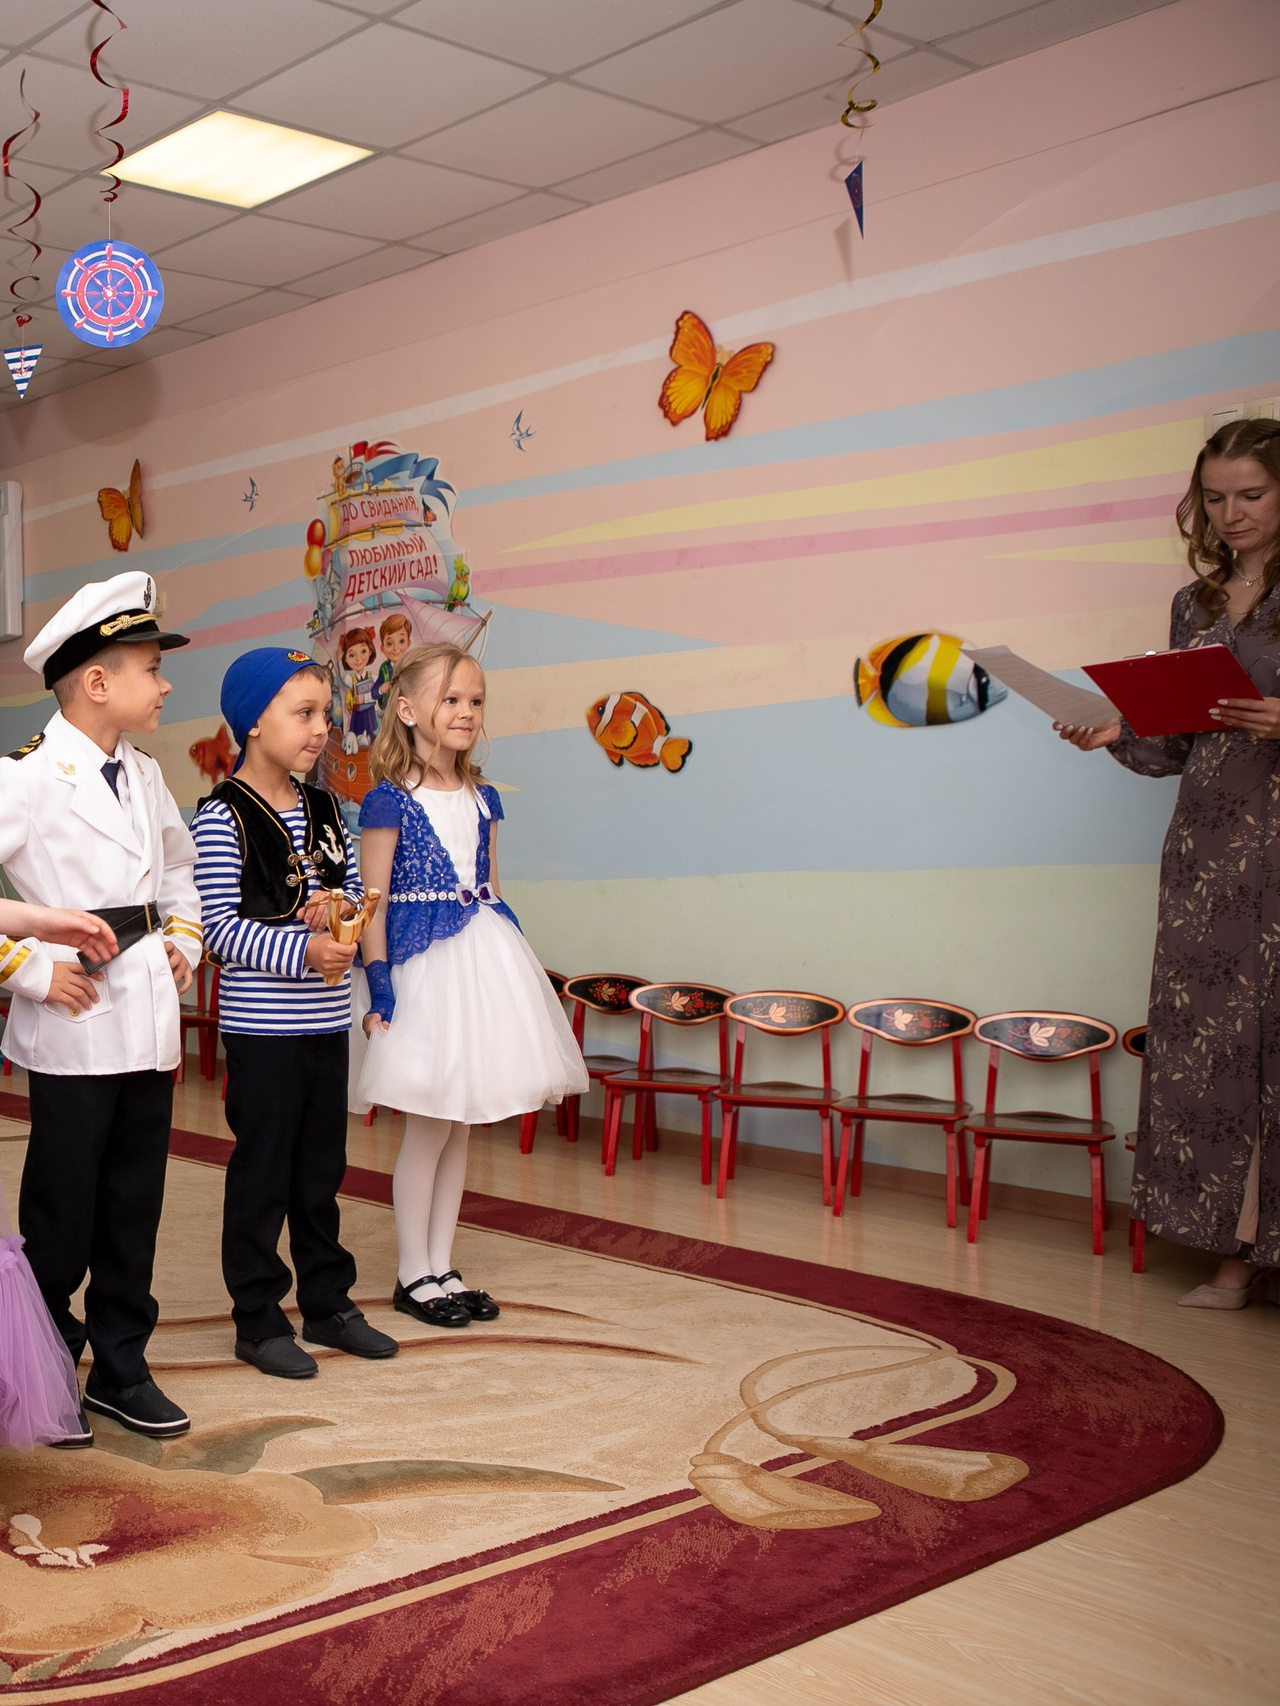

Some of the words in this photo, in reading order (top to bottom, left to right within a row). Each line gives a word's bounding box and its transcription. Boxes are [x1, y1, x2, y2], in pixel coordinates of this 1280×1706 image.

[342, 502, 358, 523] ДО
[361, 496, 419, 518] СВИДАНИЯ,
[349, 533, 427, 568] ЛЮБИМЫЙ
[345, 559, 407, 602] ДЕТСКИЙ
[409, 555, 438, 581] САД!
